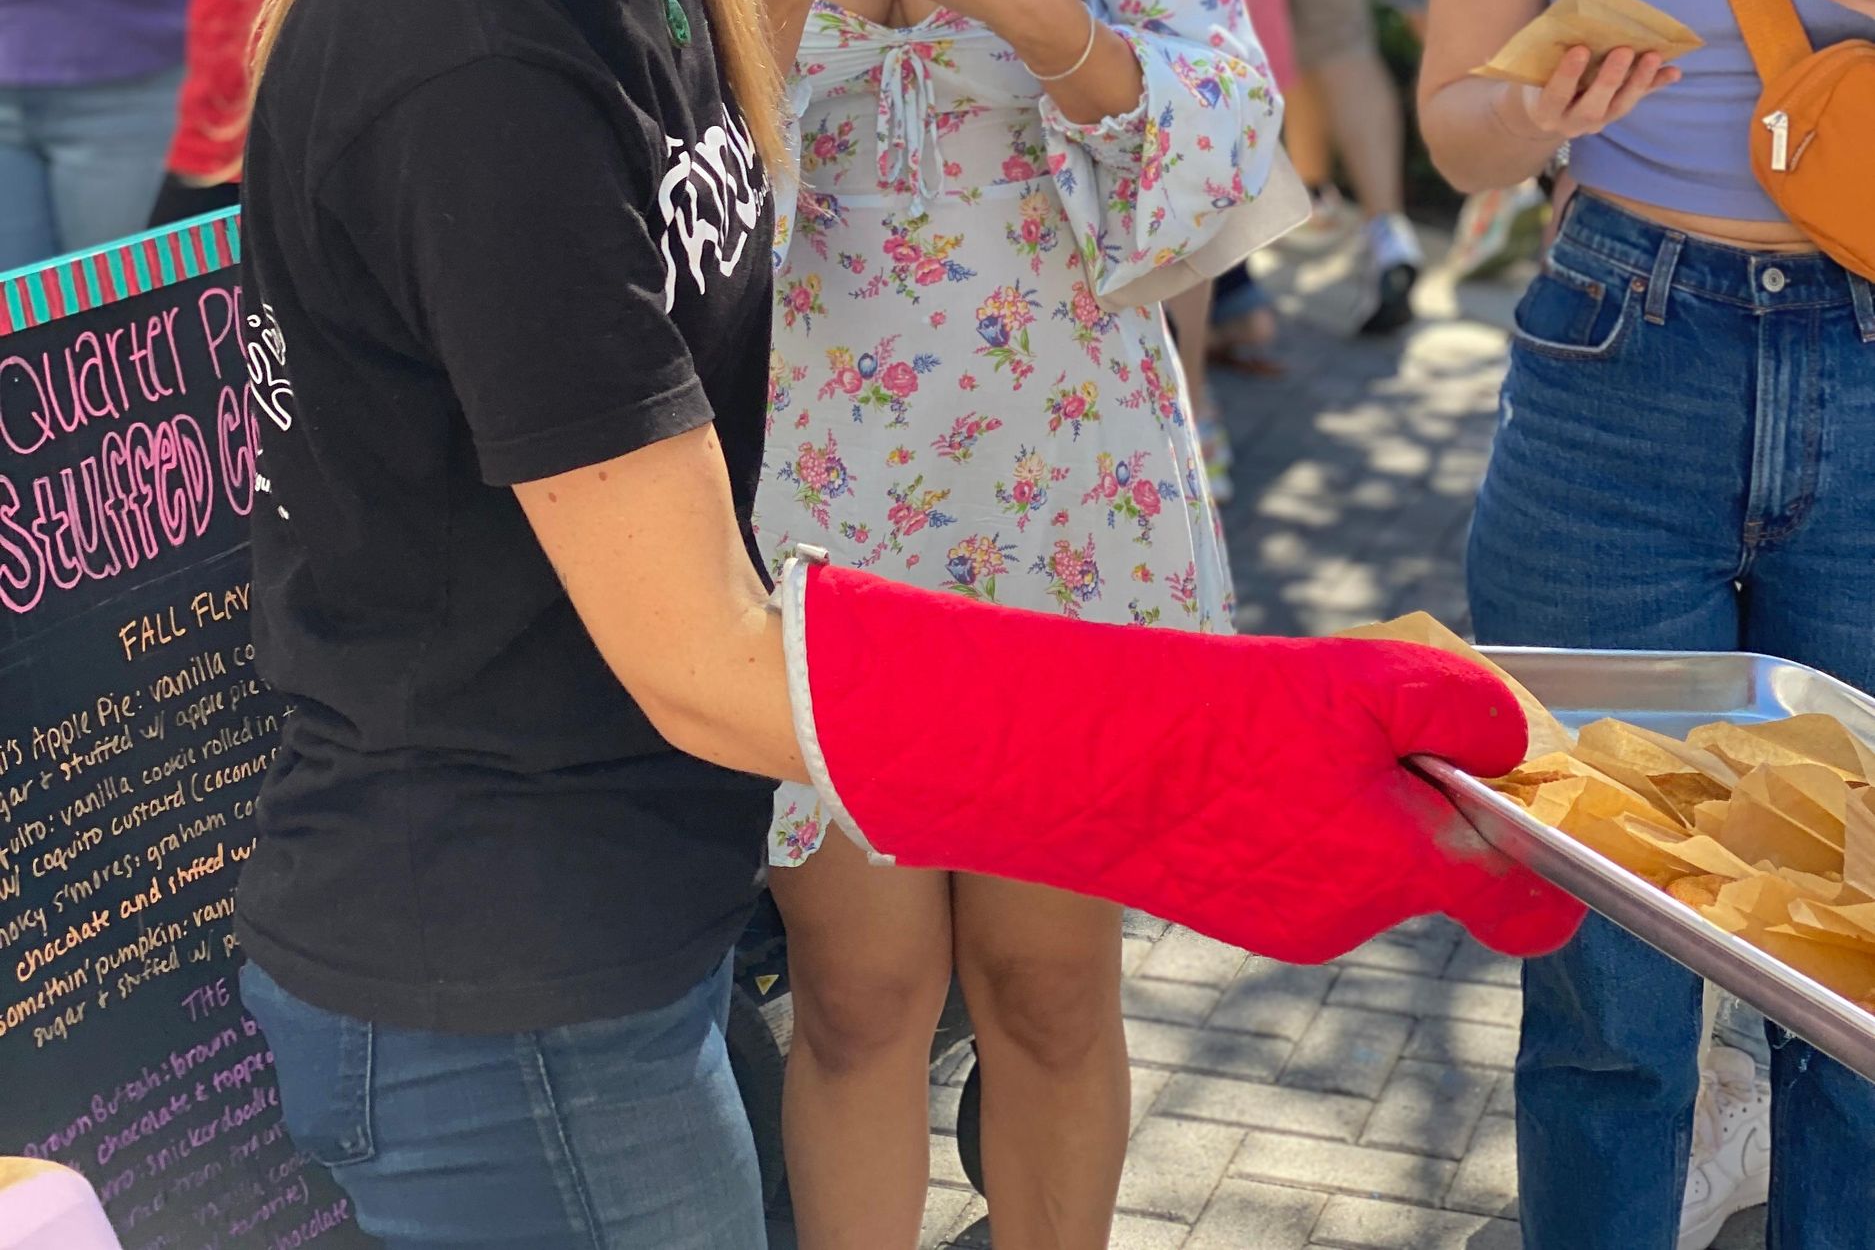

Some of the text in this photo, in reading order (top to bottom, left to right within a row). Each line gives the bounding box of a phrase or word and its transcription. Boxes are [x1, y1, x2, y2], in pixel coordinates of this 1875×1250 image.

[119, 606, 186, 661] FALL
[33, 711, 92, 761] Apple
[149, 652, 227, 702] vanilla
[60, 724, 134, 781] stuffed
[176, 692, 225, 730] apple
[61, 776, 134, 826] vanilla
[143, 749, 196, 785] cookie
[202, 717, 254, 760] rolled
[256, 714, 279, 737] in
[33, 827, 103, 878] coquito
[112, 781, 186, 837] custard
[147, 812, 227, 871] graham
[16, 909, 111, 983] chocolate
[120, 876, 162, 919] and
[168, 842, 225, 895] stuffed
[34, 1001, 87, 1048] sugar
[181, 977, 231, 1023] THE
[169, 1028, 237, 1079] brown
